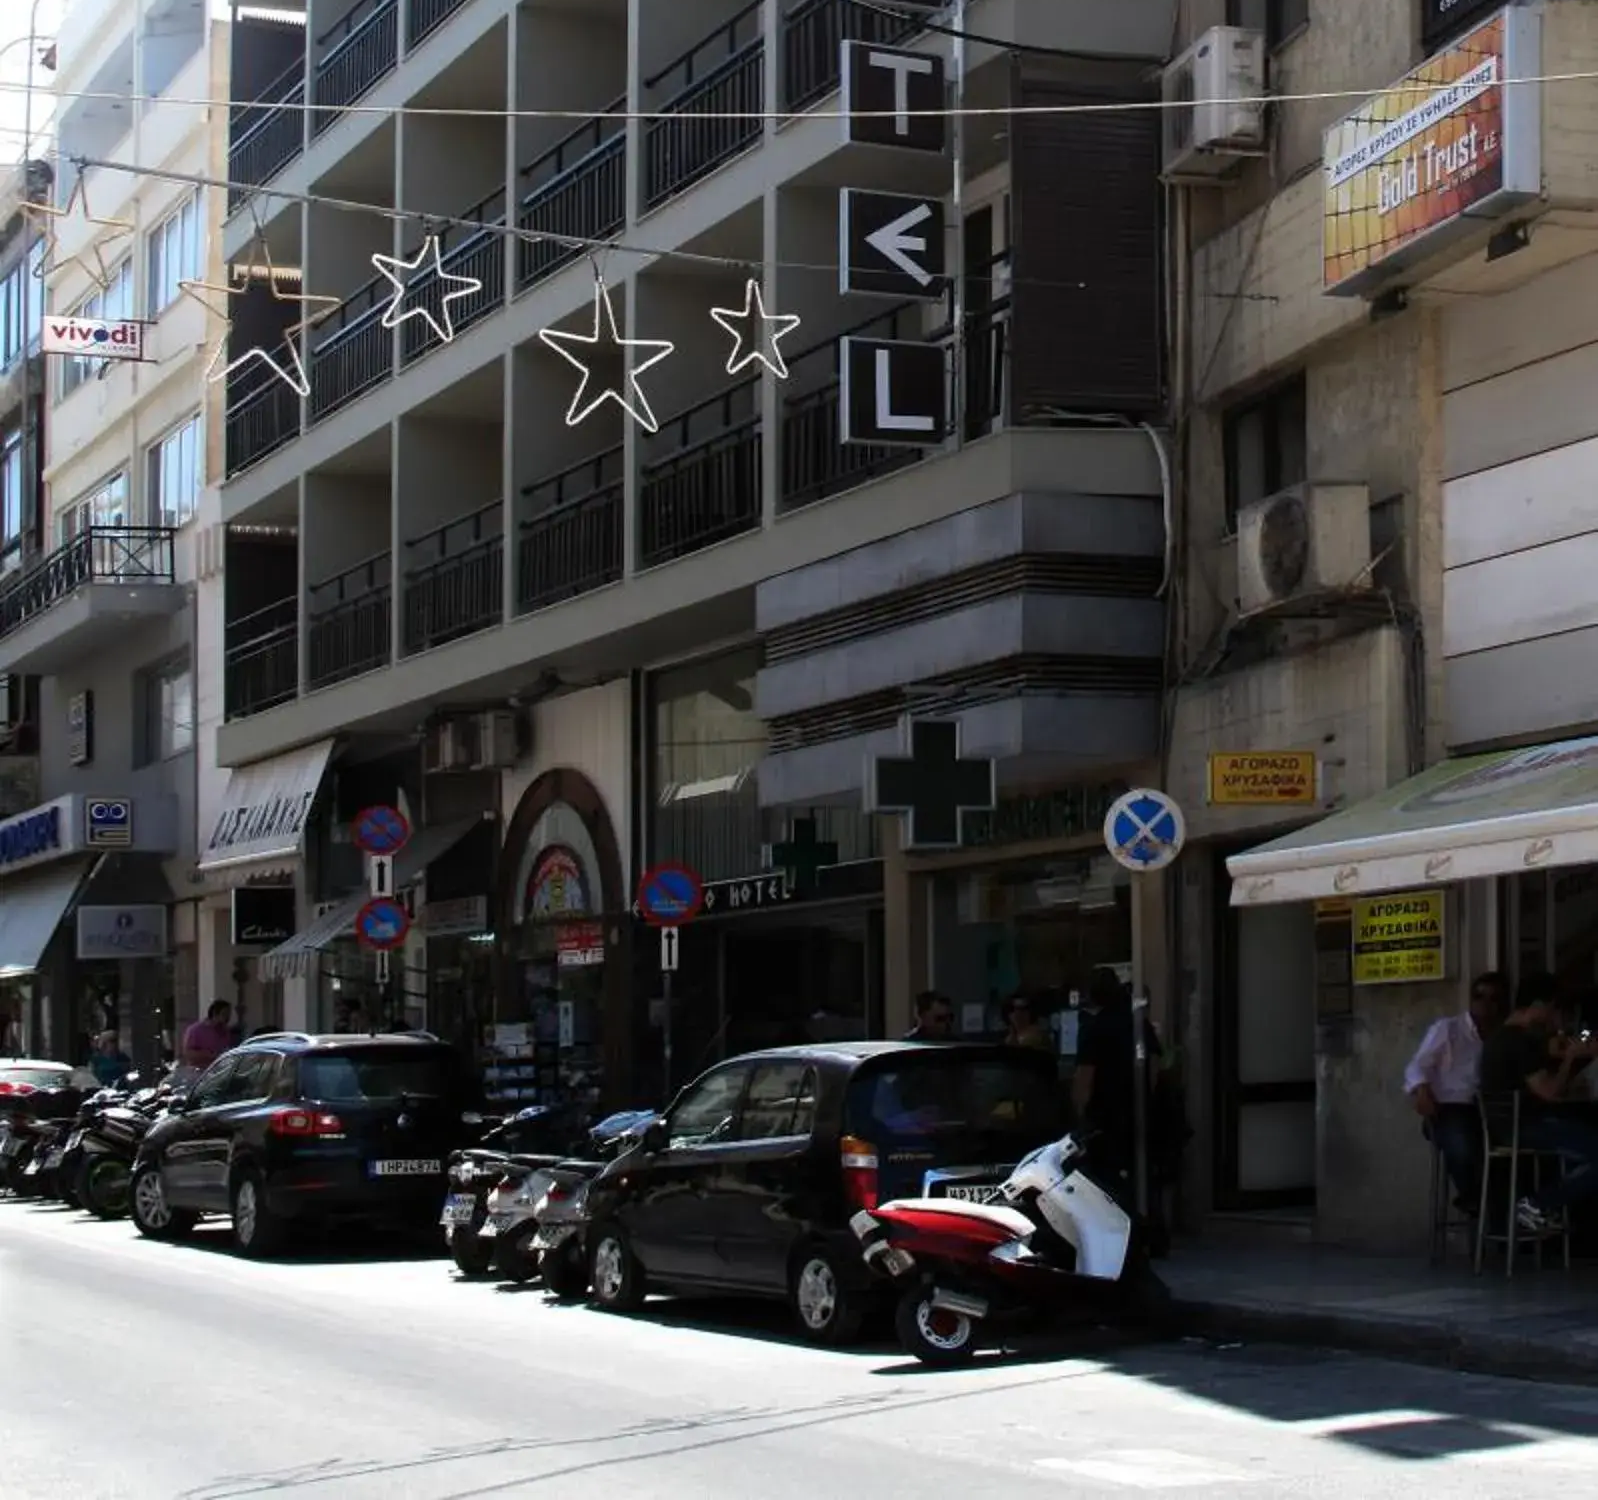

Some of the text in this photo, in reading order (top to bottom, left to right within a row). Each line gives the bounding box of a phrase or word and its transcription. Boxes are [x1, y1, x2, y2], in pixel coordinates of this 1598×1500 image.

[1379, 150, 1419, 217] Gold
[1423, 122, 1478, 187] Trust
[51, 319, 137, 345] vivodi
[1222, 773, 1306, 787] ΧΡΥΣΑΦΙΚΑ
[729, 875, 797, 909] HOTEL
[1368, 900, 1430, 918] ΑΓΟΡΑΖΩ
[1360, 919, 1439, 939] ΧΡΥΣΑΦΙΚΑ
